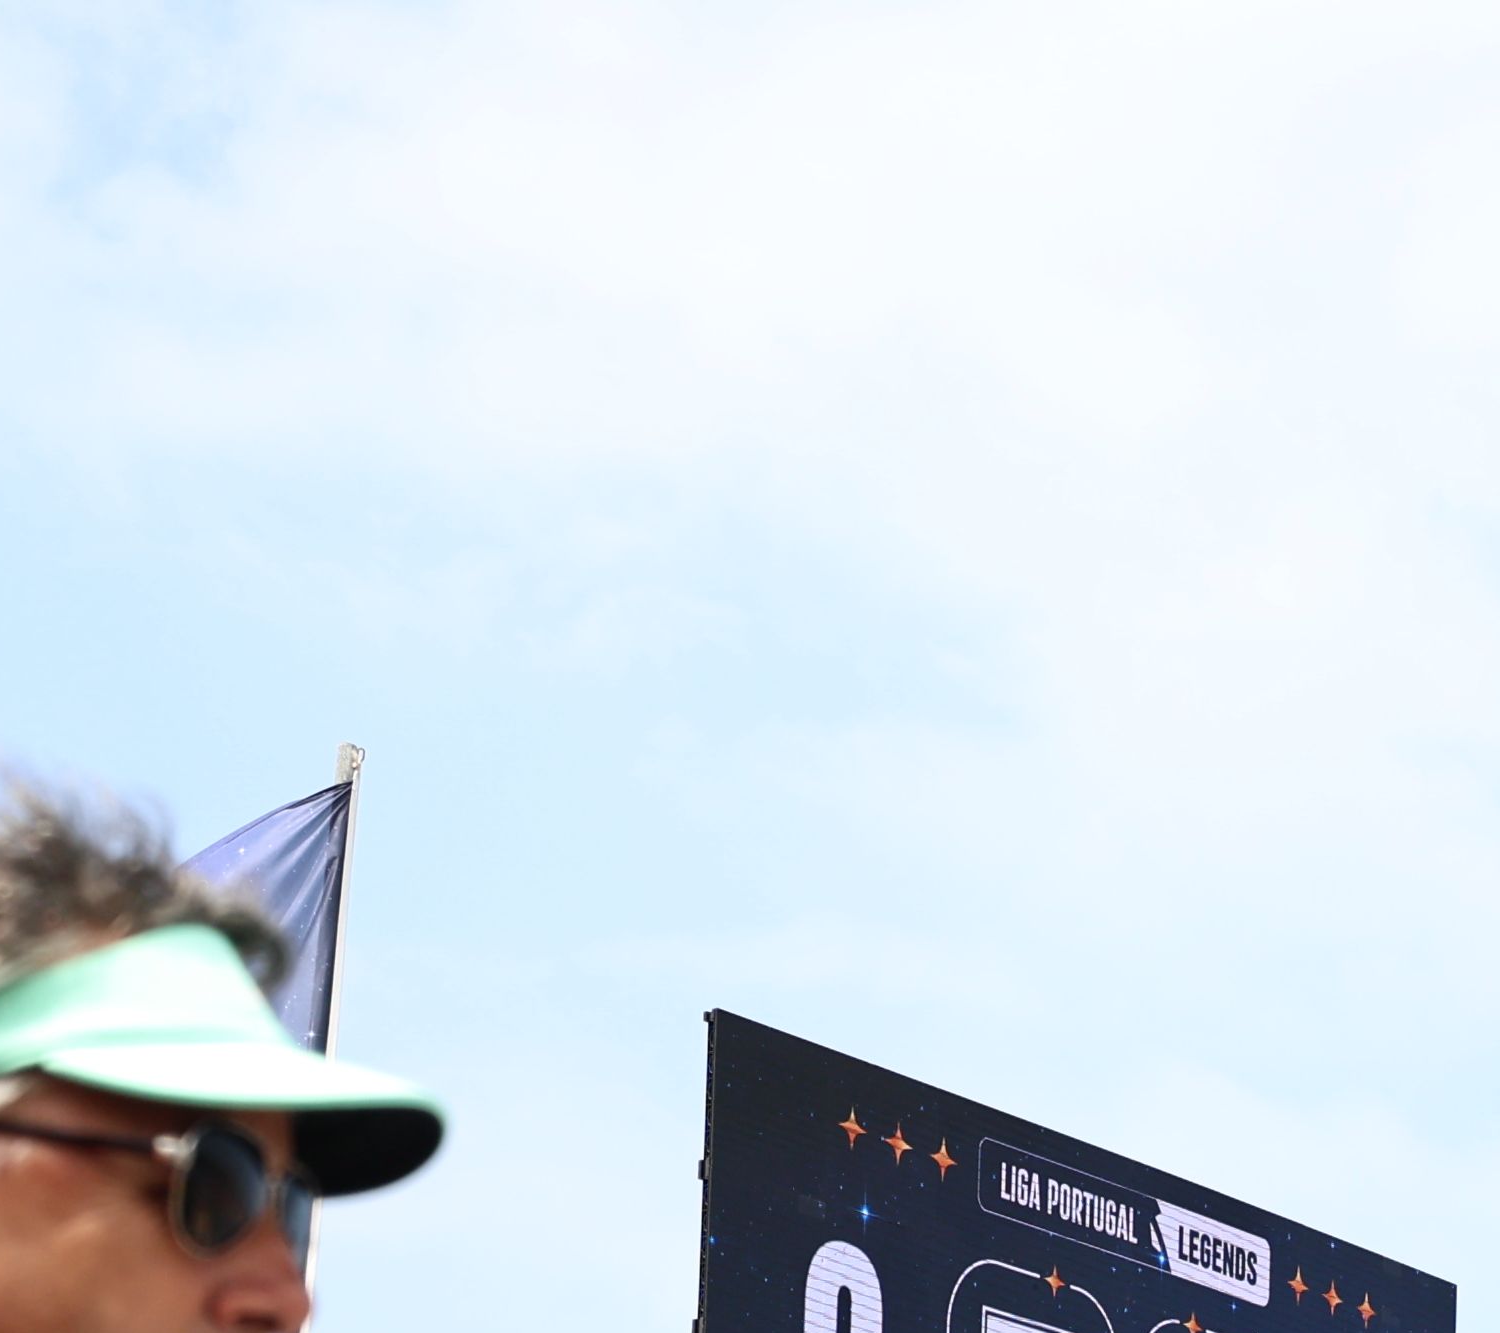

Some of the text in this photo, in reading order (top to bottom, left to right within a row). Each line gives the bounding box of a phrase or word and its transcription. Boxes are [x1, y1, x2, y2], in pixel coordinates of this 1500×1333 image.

[1000, 1161, 1258, 1286] LIGA PORTUGAL LEGENDS
